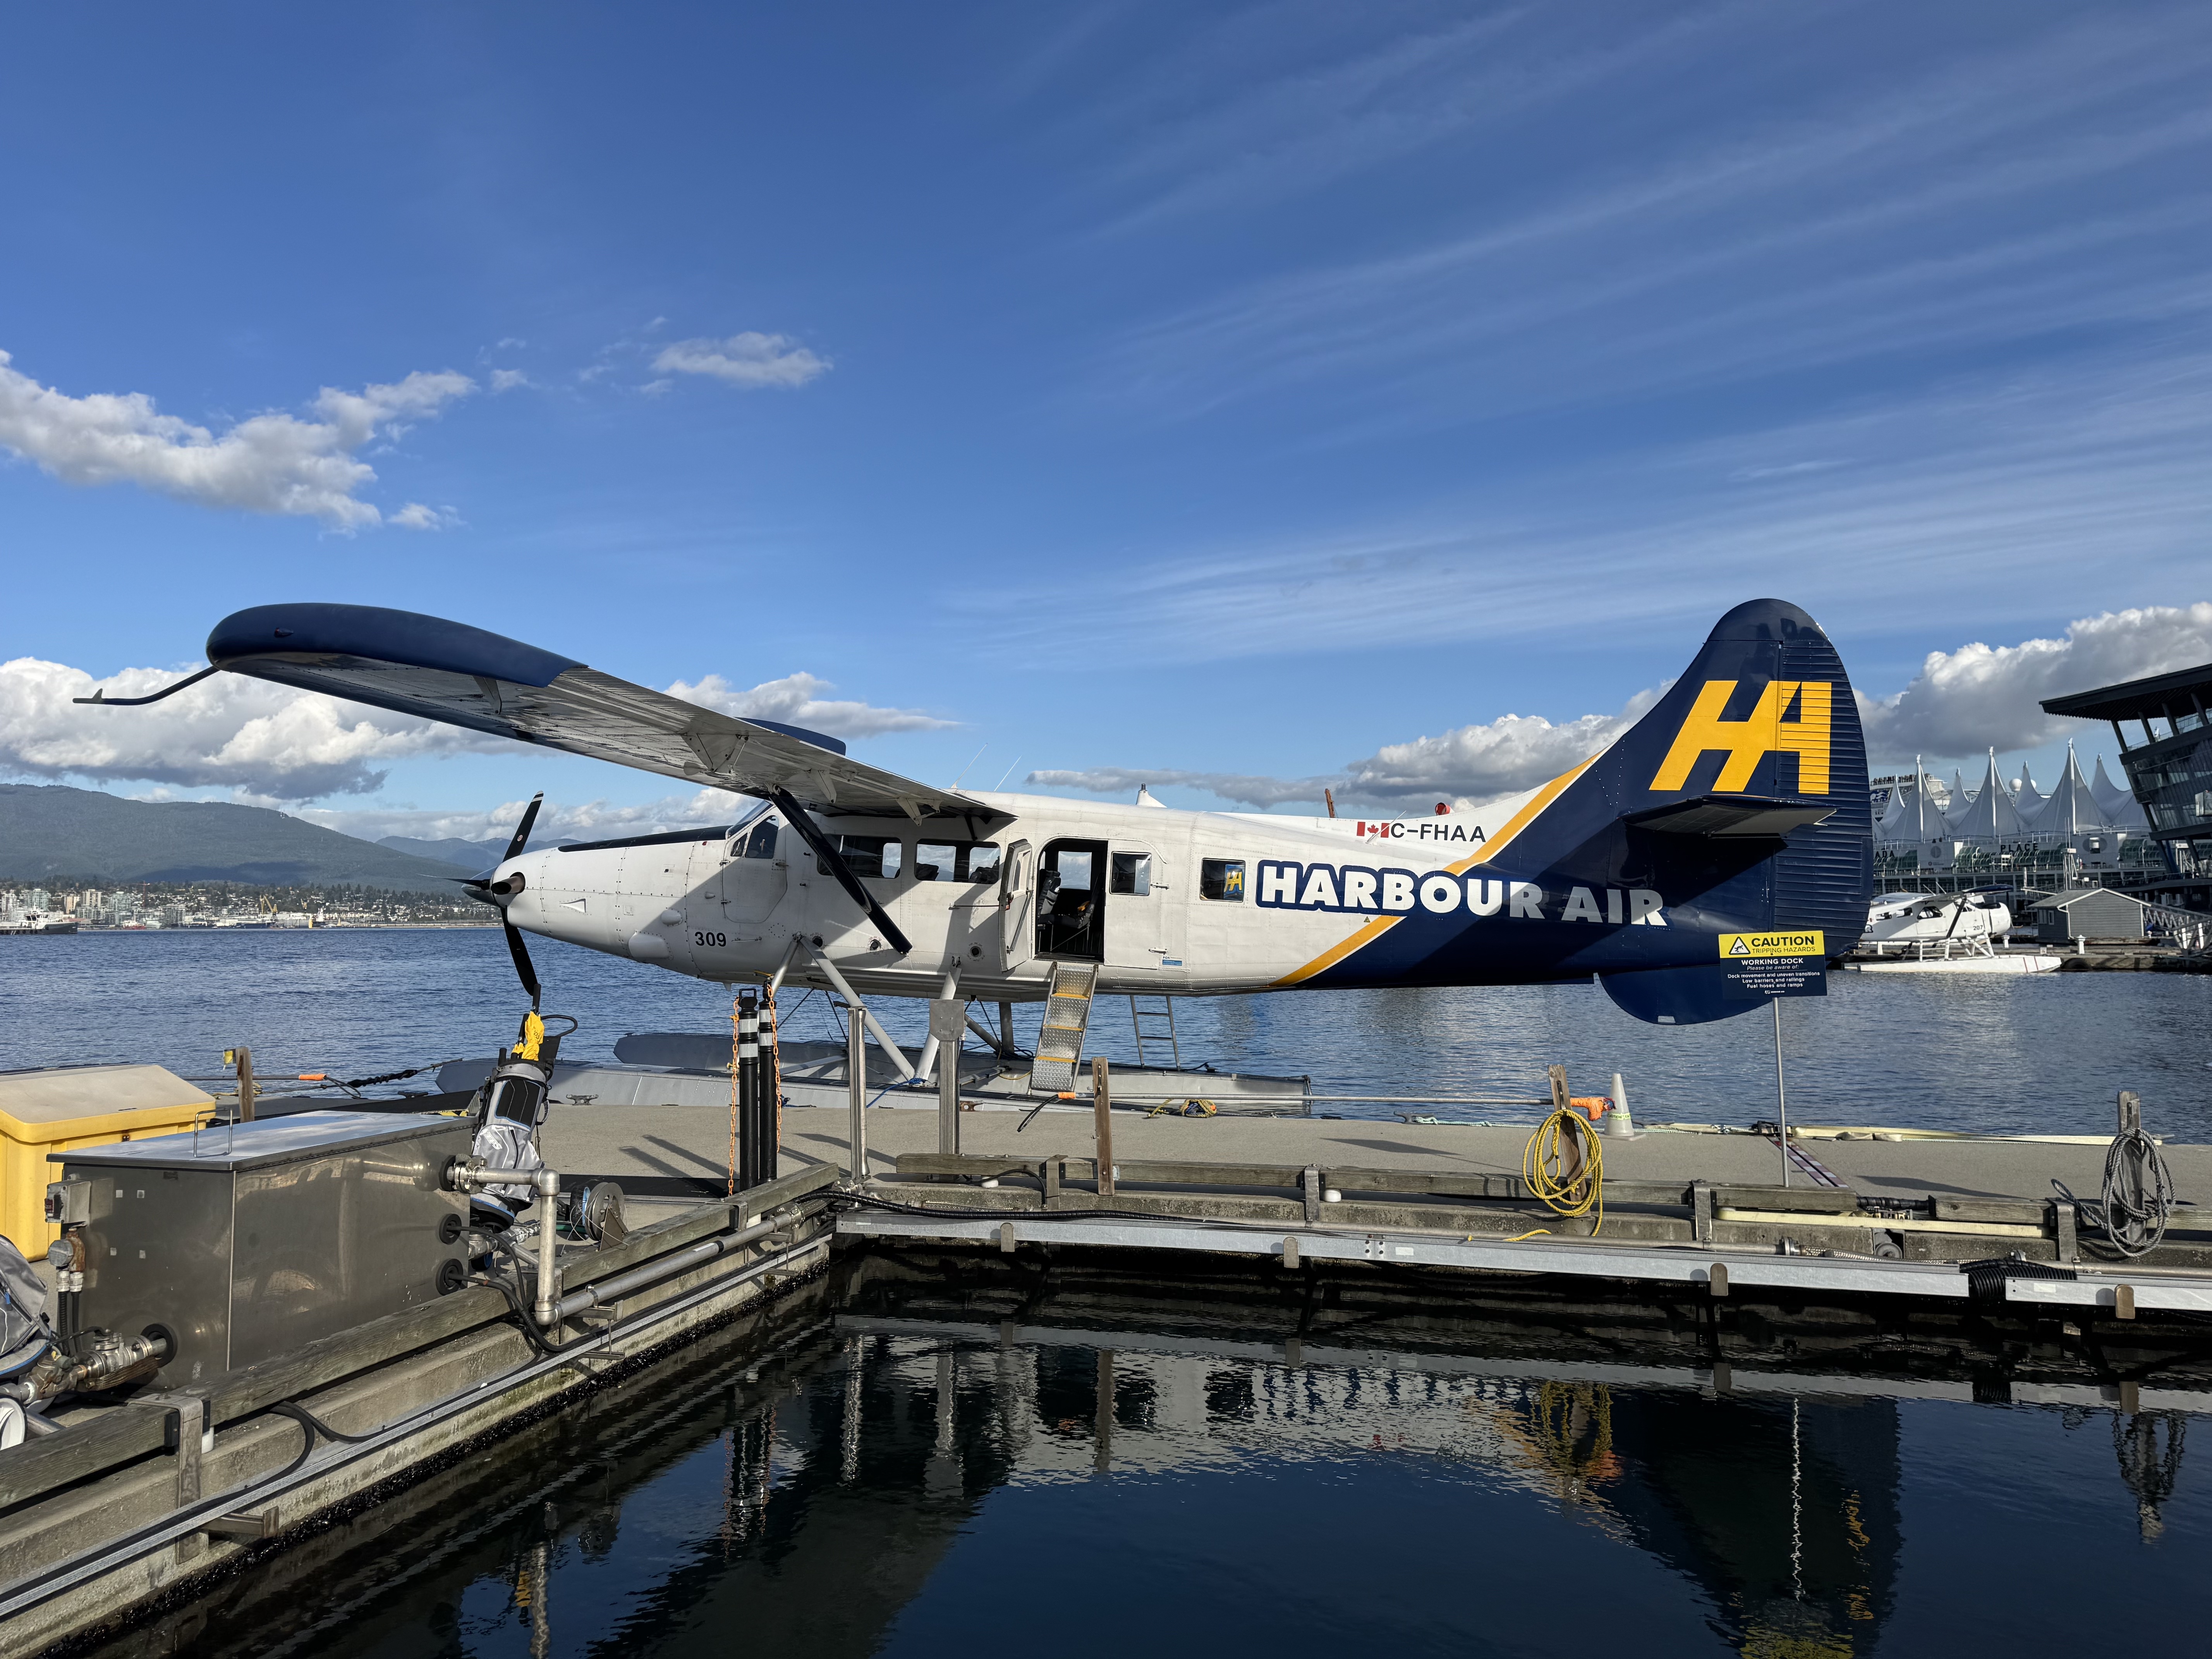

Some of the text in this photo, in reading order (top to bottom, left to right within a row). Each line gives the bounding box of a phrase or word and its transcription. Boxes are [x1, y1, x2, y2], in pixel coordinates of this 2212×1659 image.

[1649, 680, 1832, 794] HA
[1391, 823, 1486, 843] C-FHAA
[2001, 843, 2039, 852] PLACE
[1261, 866, 1668, 926] HARBOUR AIR
[694, 931, 726, 947] 309
[1751, 936, 1814, 947] CAUTION
